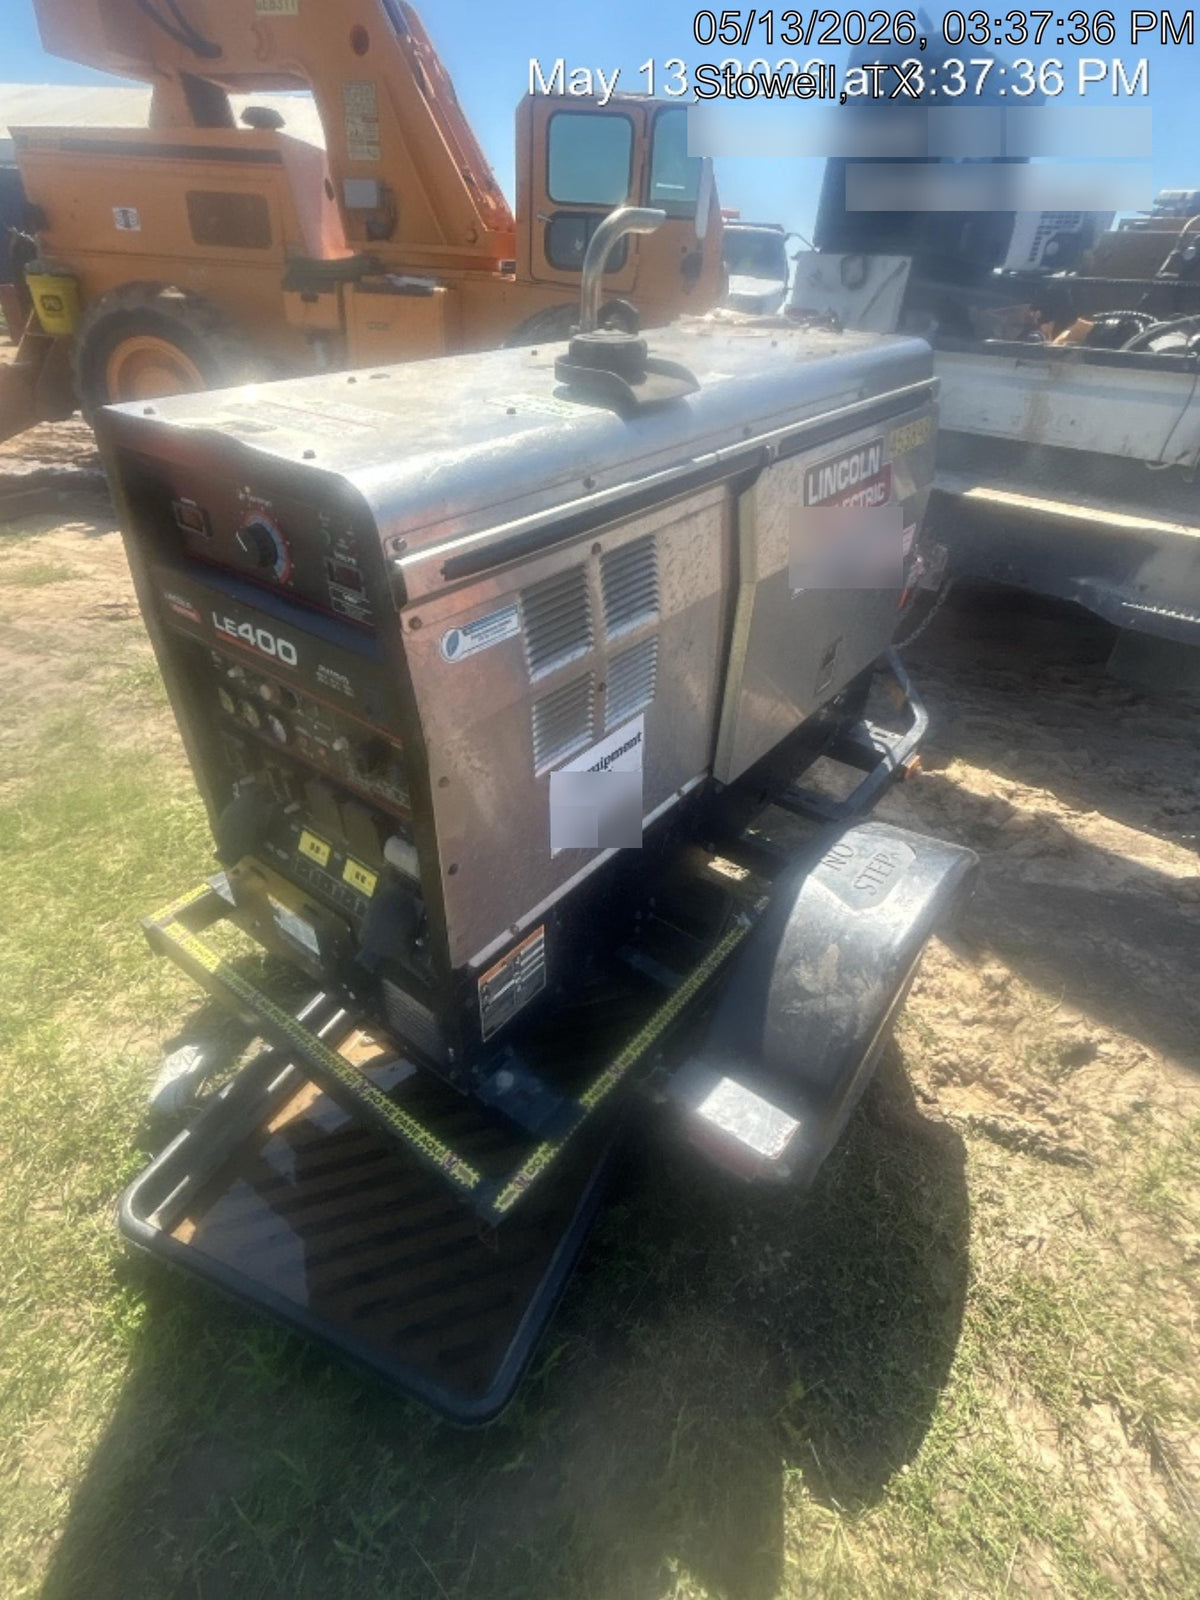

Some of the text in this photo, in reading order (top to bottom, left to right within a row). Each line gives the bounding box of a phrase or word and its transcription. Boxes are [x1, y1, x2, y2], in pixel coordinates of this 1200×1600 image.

[808, 445, 881, 506] LINCOLN
[834, 481, 886, 508] ECTRIC
[212, 611, 298, 667] LE400
[821, 843, 855, 872] NO
[853, 851, 897, 897] STEP
[365, 1090, 383, 1106] NO
[393, 1113, 421, 1138] PARE
[524, 1155, 544, 1176] DO
